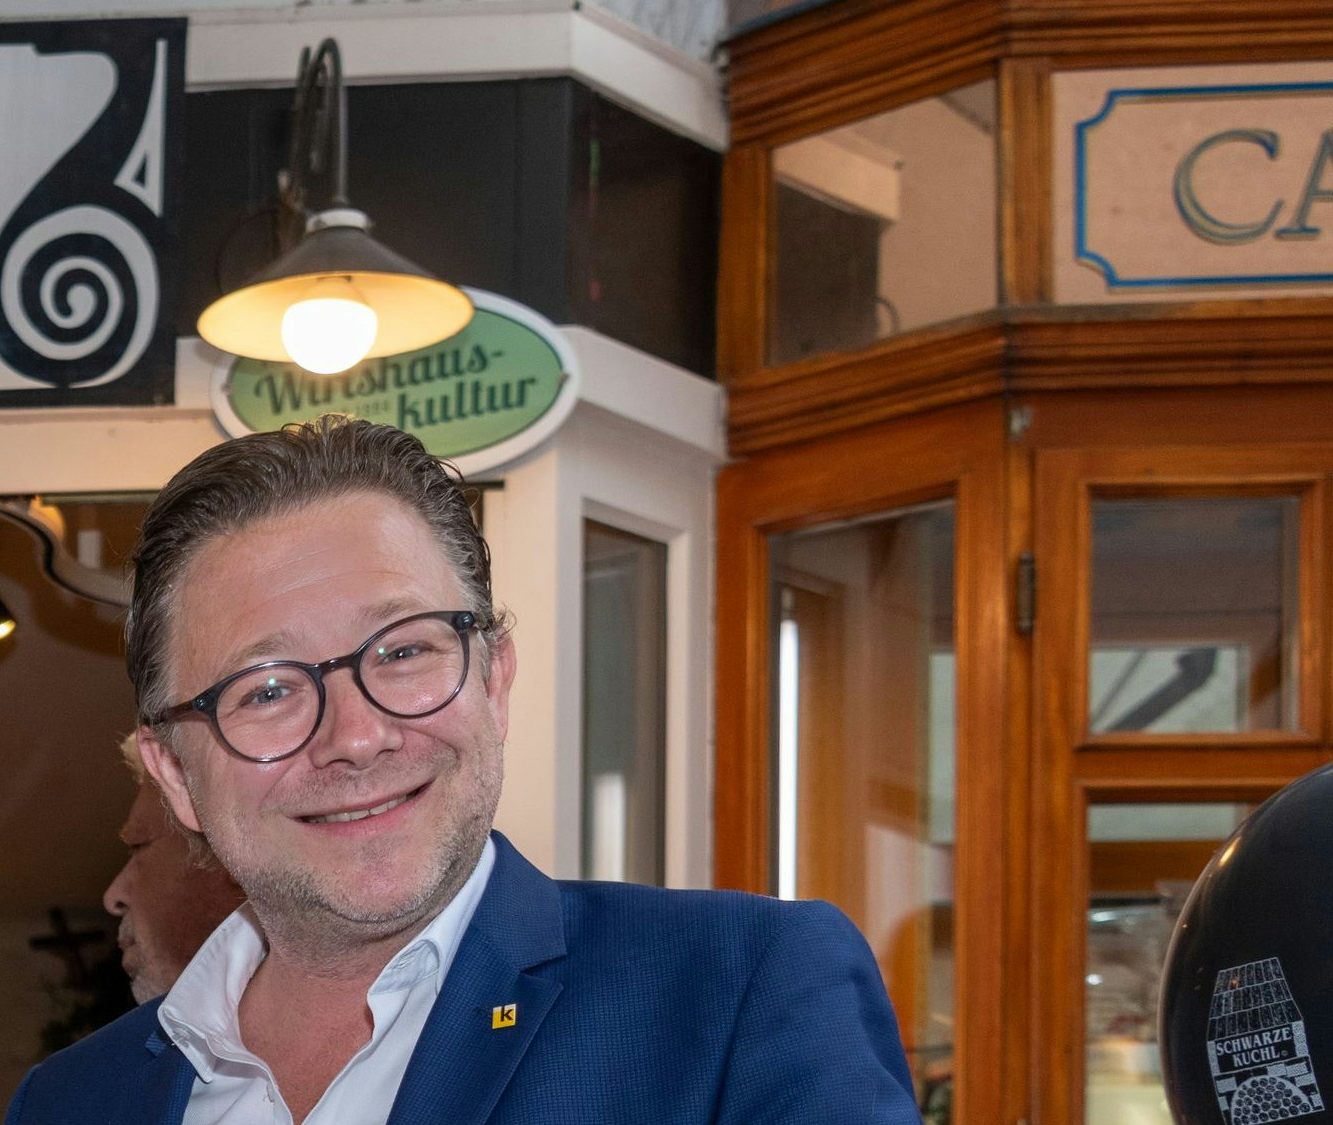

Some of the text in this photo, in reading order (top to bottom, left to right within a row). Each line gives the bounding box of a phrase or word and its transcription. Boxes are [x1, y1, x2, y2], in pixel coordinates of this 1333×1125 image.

[396, 374, 539, 431] kultur
[1216, 1027, 1293, 1056] SCHWARZE
[1232, 1045, 1281, 1067] KUCHL
